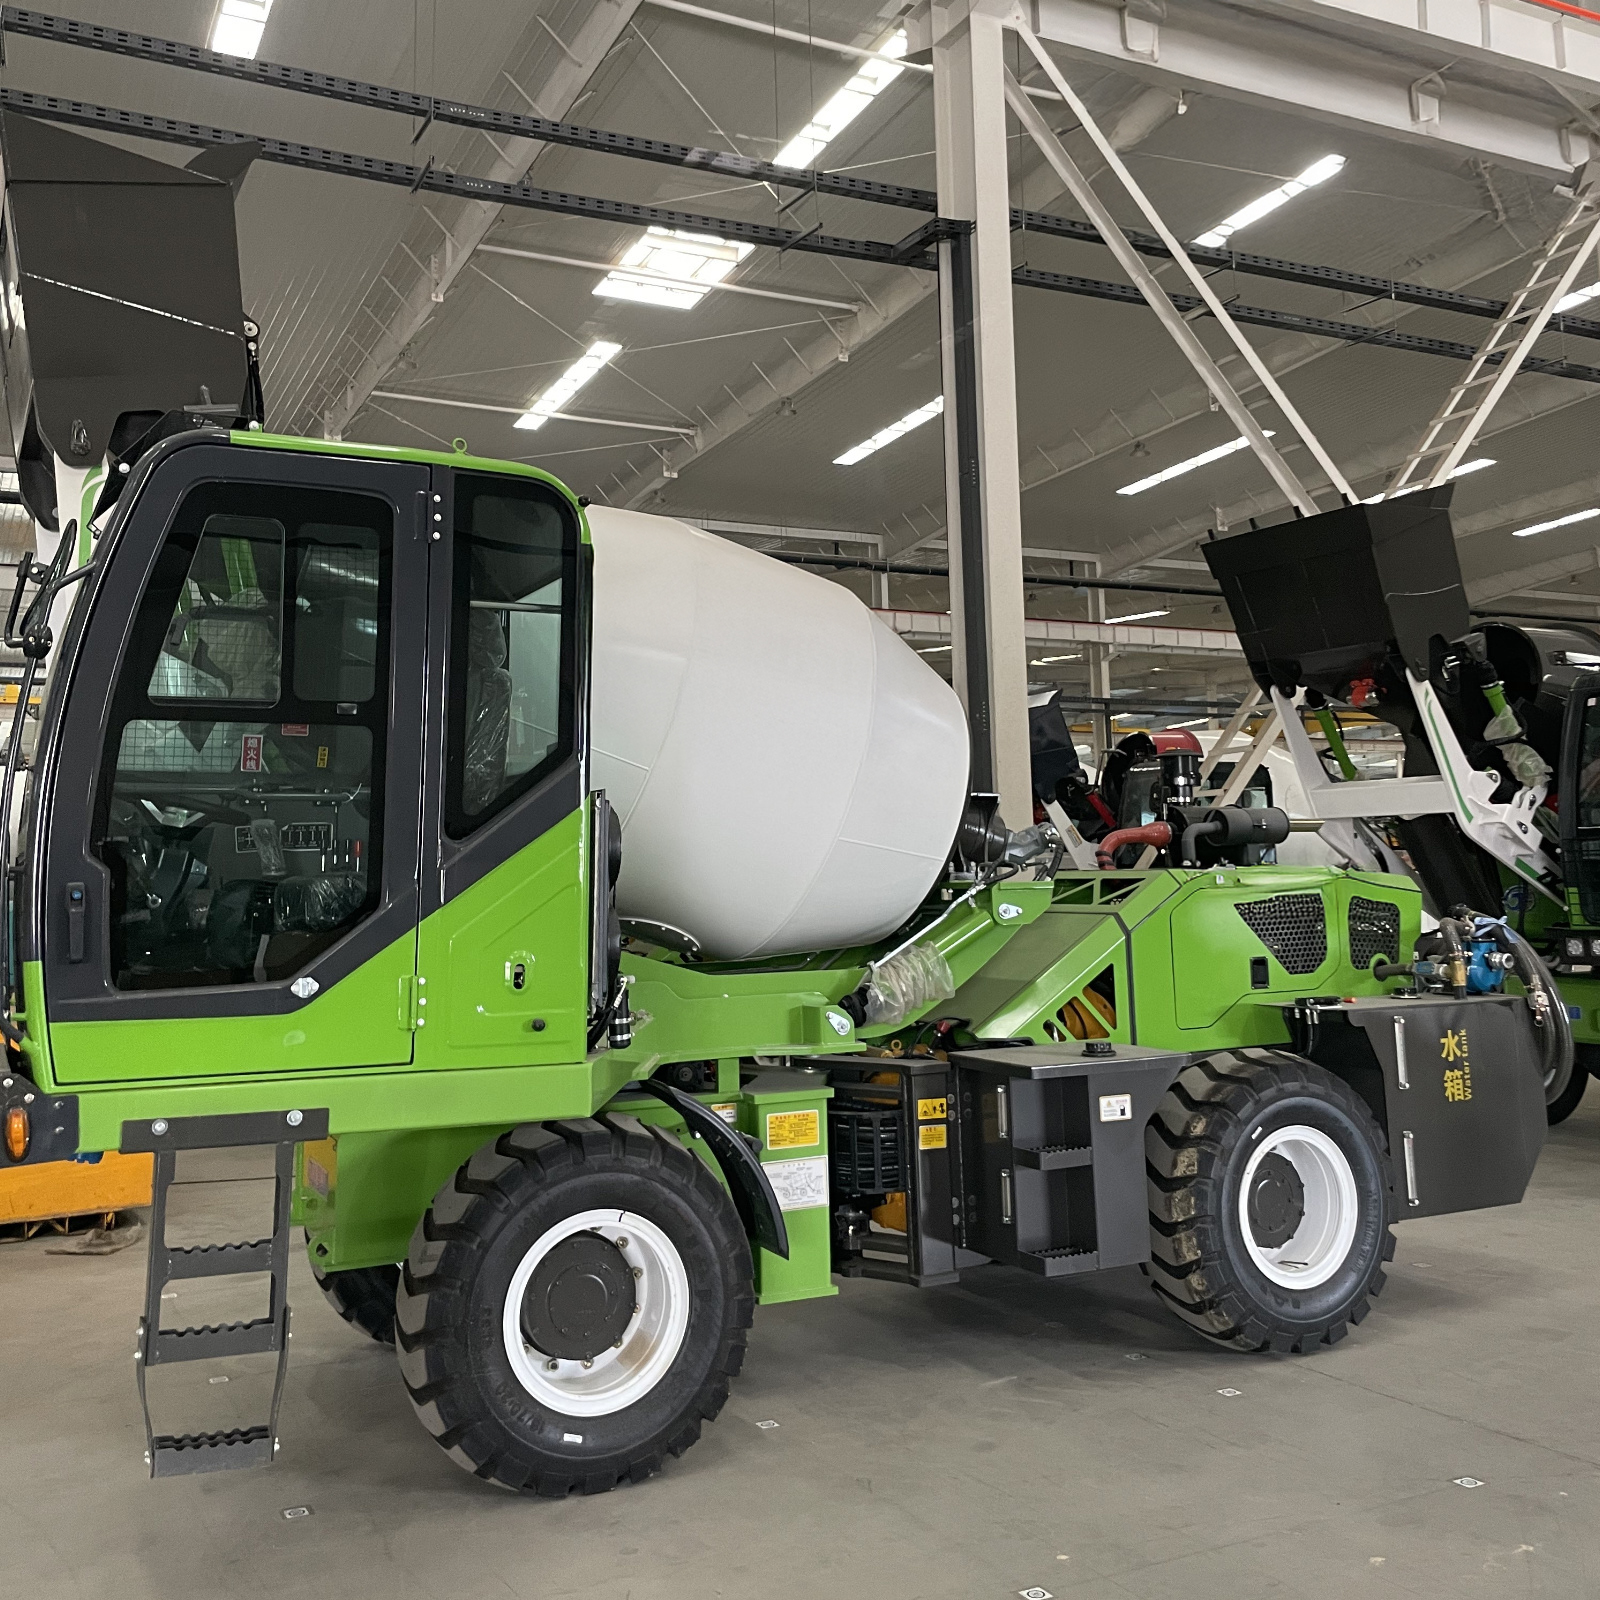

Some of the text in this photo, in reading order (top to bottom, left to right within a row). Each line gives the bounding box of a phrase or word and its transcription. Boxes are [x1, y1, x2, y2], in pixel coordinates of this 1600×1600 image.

[1440, 1029, 1464, 1102] 水箱
[1459, 1028, 1472, 1100] Water tank
